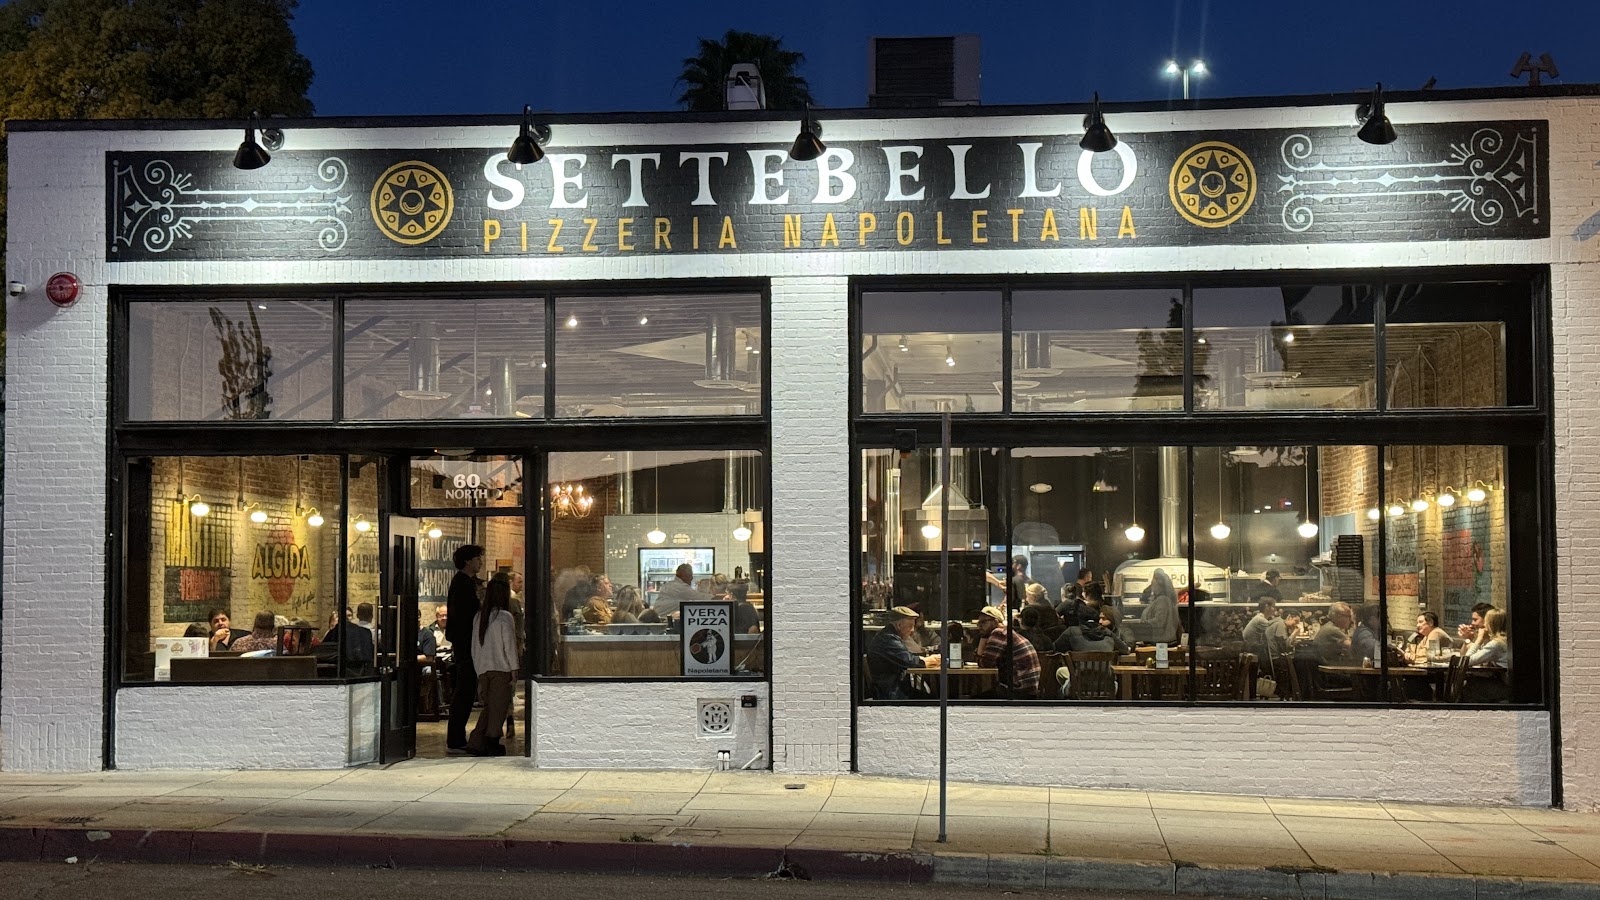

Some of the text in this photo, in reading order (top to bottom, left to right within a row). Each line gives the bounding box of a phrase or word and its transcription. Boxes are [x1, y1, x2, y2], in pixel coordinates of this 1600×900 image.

[483, 139, 1138, 211] SETTEBELLO
[483, 206, 1137, 252] PIZZERIA NAPOLETANA
[445, 488, 488, 499] NORTH
[453, 473, 481, 489] 60
[252, 543, 311, 580] ALGIDA
